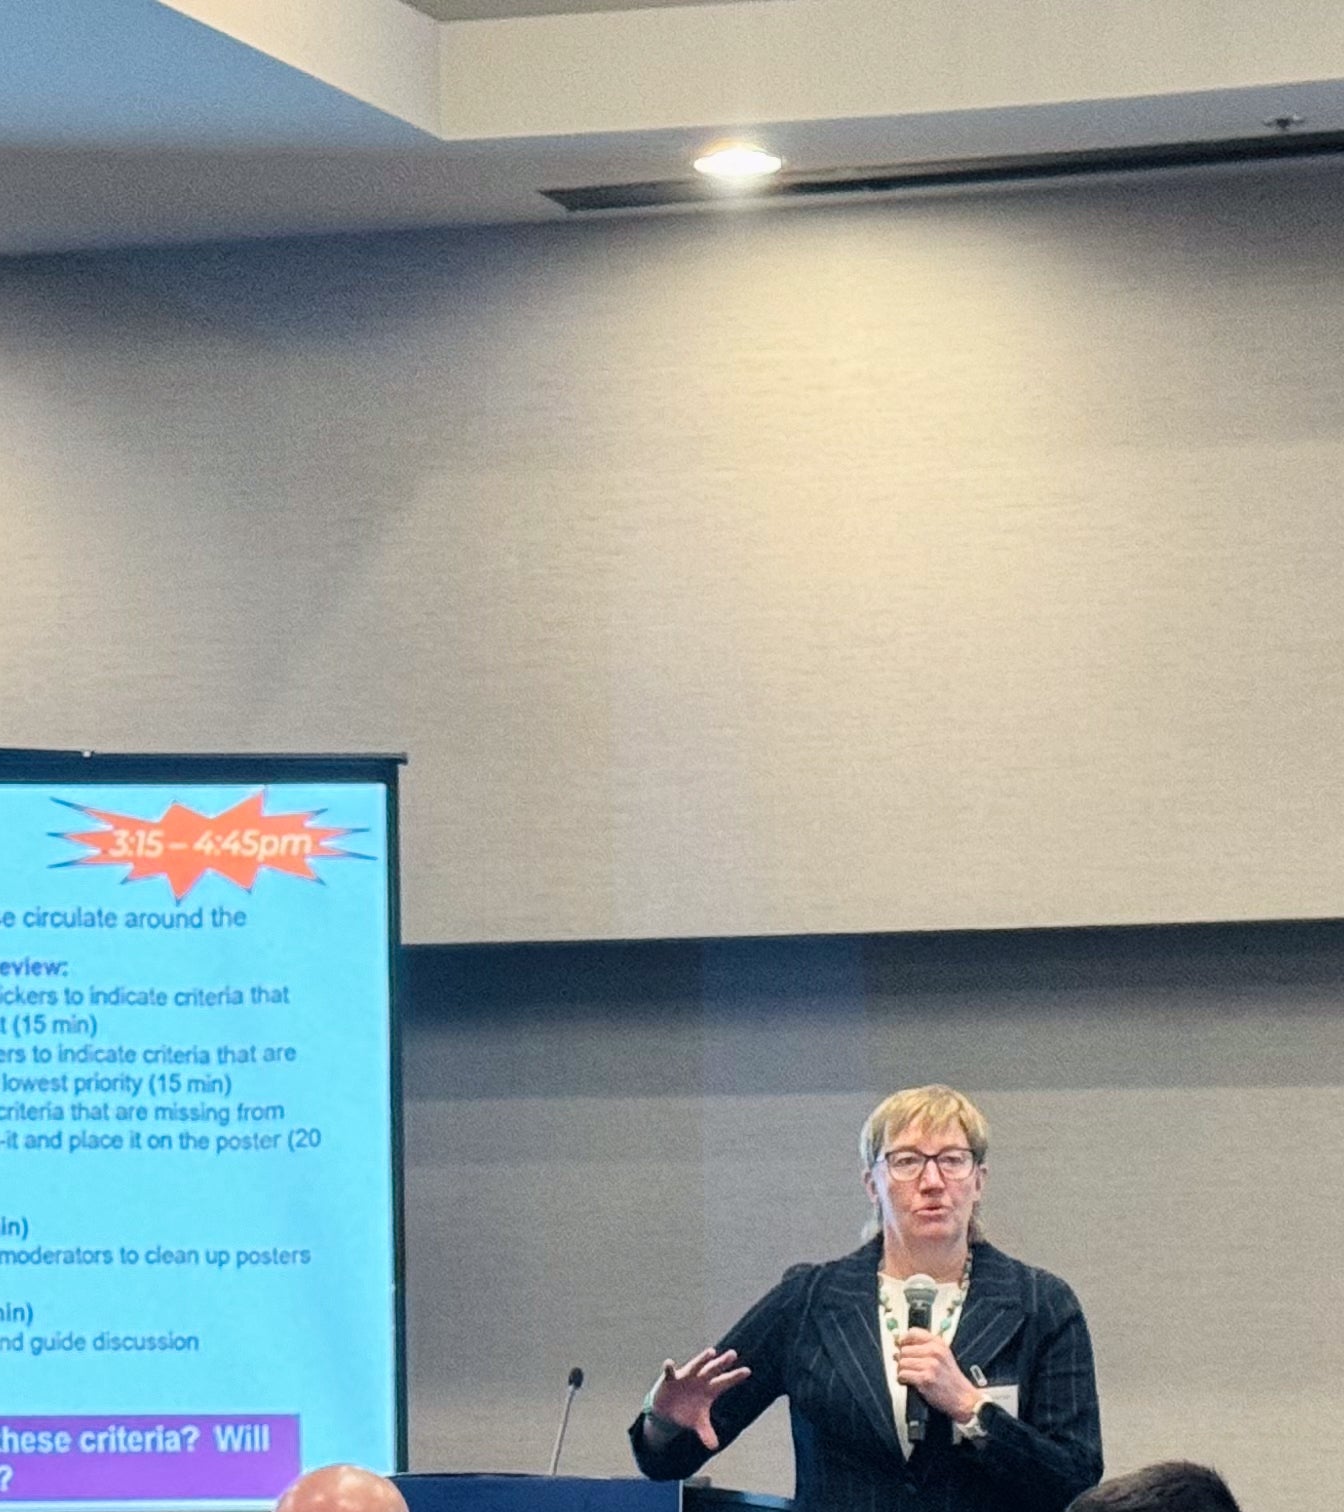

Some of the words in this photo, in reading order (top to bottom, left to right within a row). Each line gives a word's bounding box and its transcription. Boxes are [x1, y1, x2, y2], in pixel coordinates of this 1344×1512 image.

[108, 829, 165, 858] 3:15
[193, 829, 313, 862] 4:45pm
[22, 905, 118, 929] circulate
[124, 904, 204, 930] around
[210, 905, 247, 929] the
[63, 986, 85, 1007] to
[89, 984, 168, 1007] indicate
[172, 984, 245, 1008] criteria
[249, 984, 290, 1005] that
[11, 1012, 47, 1040] (15
[51, 1013, 98, 1039] min)
[31, 1044, 53, 1065] to
[57, 1042, 138, 1067] indicate
[141, 1044, 212, 1067] criteria
[216, 1044, 257, 1067] that
[262, 1046, 297, 1063] are
[1, 1071, 69, 1093] lowest
[73, 1071, 144, 1099] priority
[147, 1072, 183, 1098] (15
[186, 1073, 233, 1099] min)
[69, 1101, 111, 1122] that
[114, 1104, 149, 1122] are
[153, 1102, 231, 1127] missing
[236, 1102, 286, 1123] from
[23, 1129, 63, 1152] and
[68, 1128, 124, 1155] place
[129, 1130, 143, 1151] it
[146, 1133, 173, 1151] on
[178, 1130, 210, 1151] the
[215, 1132, 282, 1156] poster
[287, 1128, 322, 1154] (20
[119, 1246, 140, 1266] to
[143, 1244, 200, 1267] clean
[204, 1249, 231, 1271] up
[235, 1247, 311, 1271] posters
[29, 1330, 87, 1357] guide
[91, 1329, 200, 1352] discussion
[78, 1424, 201, 1453] criteria?
[213, 1423, 270, 1452] Will
